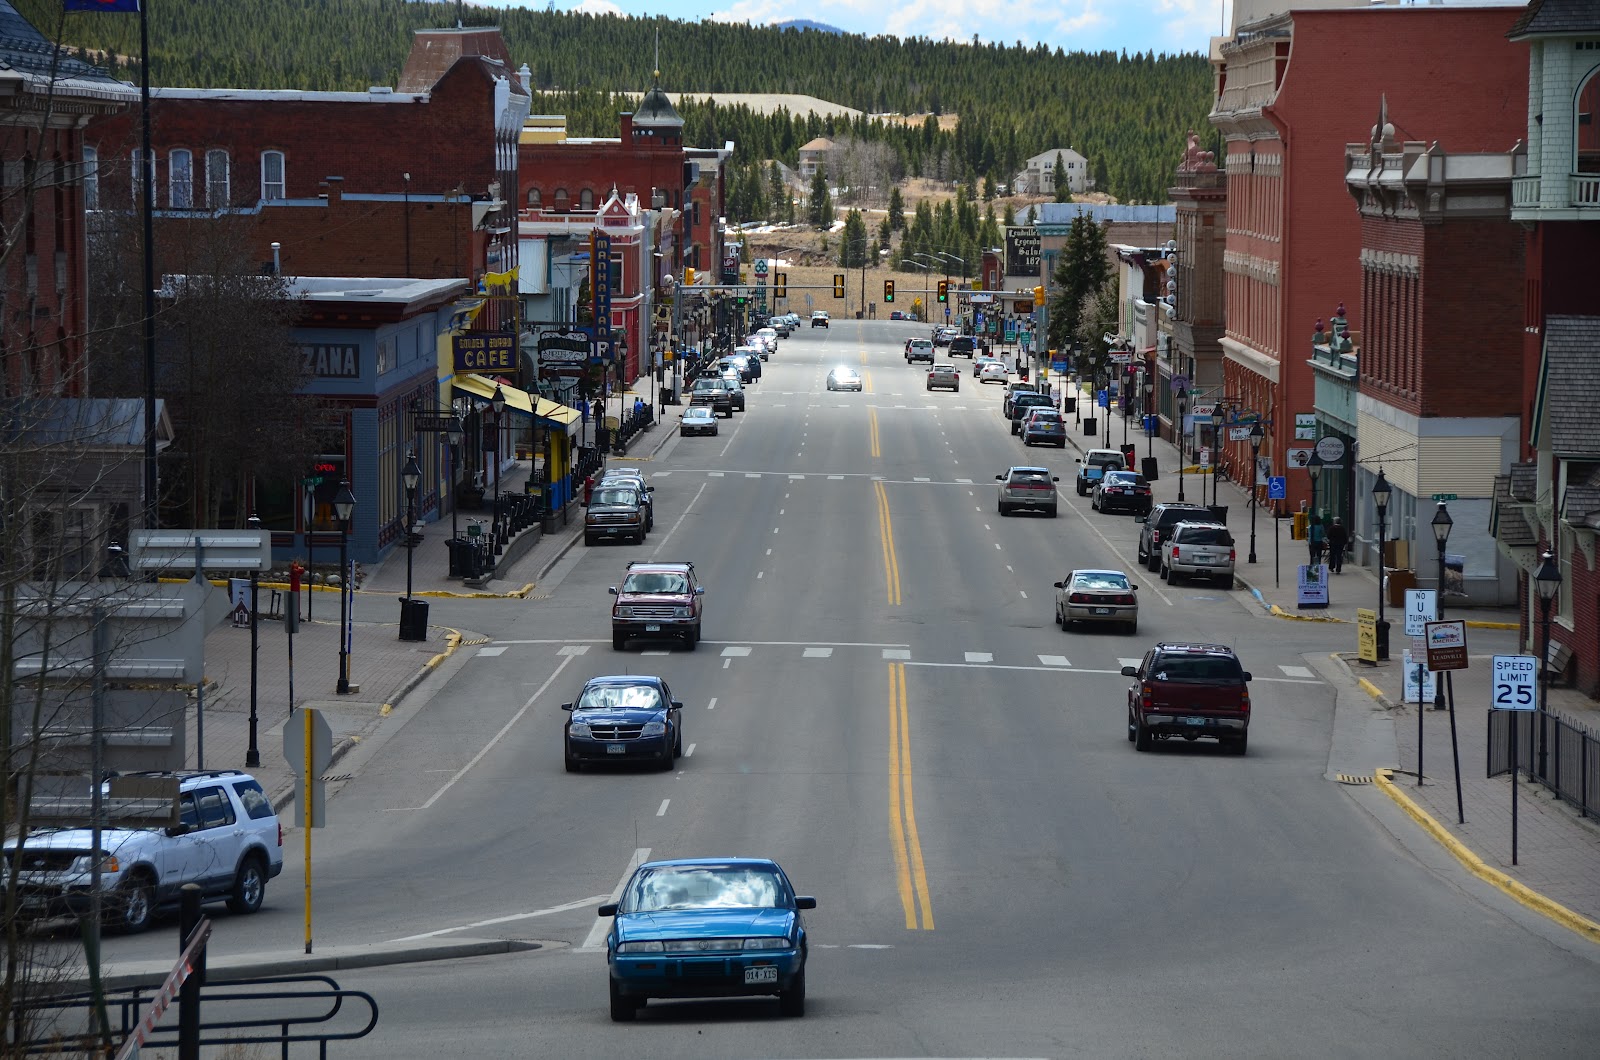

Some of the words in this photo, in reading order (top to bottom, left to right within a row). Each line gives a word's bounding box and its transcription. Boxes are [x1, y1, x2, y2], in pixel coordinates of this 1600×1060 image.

[597, 239, 609, 336] MANHATTAN
[458, 338, 485, 349] GOLDEN
[464, 350, 509, 367] CAFE
[1319, 441, 1343, 449] Cookies
[313, 463, 336, 474] OPEN
[1415, 592, 1426, 600] NO
[1417, 602, 1424, 613] U
[1409, 614, 1432, 622] TURNS
[1431, 624, 1461, 633] PRESERVE
[1496, 661, 1534, 671] SPEED
[1500, 673, 1529, 682] LIMIT
[1497, 684, 1533, 705] 25
[746, 969, 777, 980] 014-XIS
